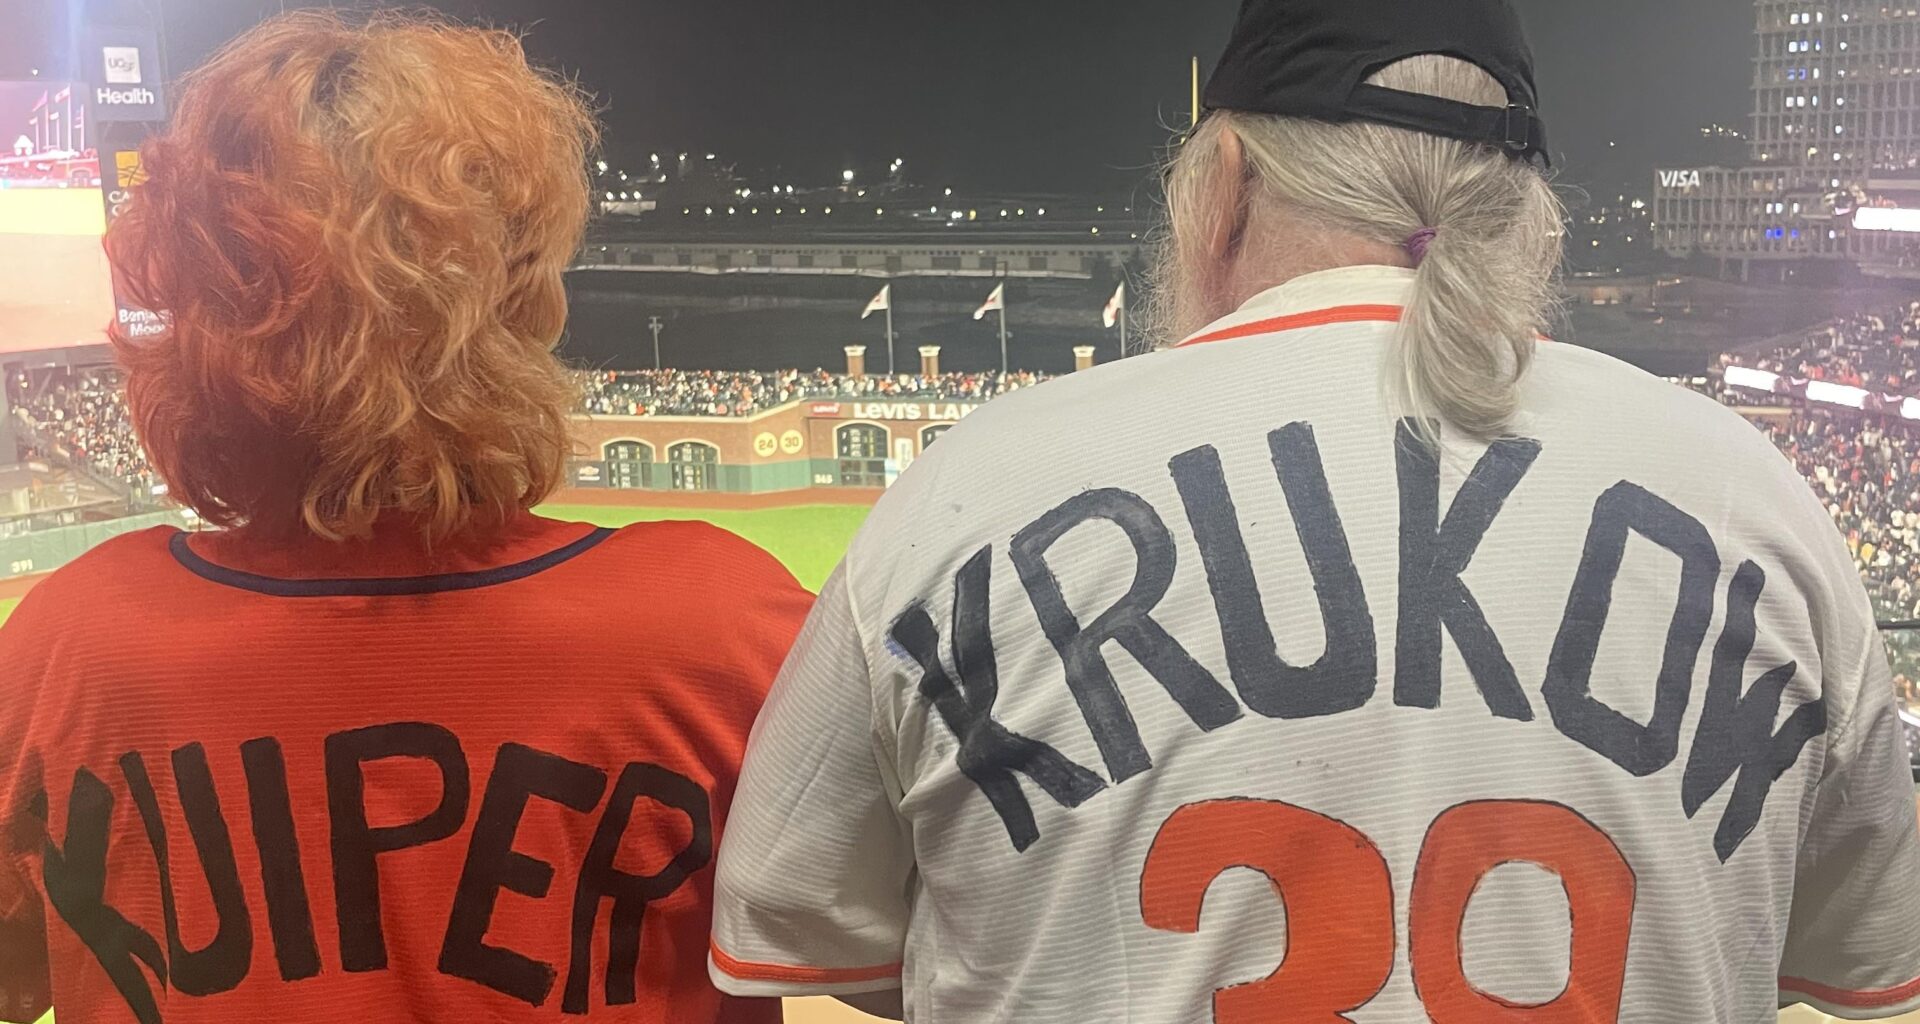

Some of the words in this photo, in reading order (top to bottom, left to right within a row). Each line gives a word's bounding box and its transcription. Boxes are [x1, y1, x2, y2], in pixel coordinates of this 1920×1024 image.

[97, 87, 155, 105] Health
[1659, 170, 1700, 187] VISA
[759, 439, 773, 450] 24
[785, 436, 799, 447] 30
[11, 559, 33, 573] 391
[889, 420, 1828, 864] KRUKOW
[29, 721, 712, 1024] KUIPER
[1139, 797, 1636, 1024] 39
